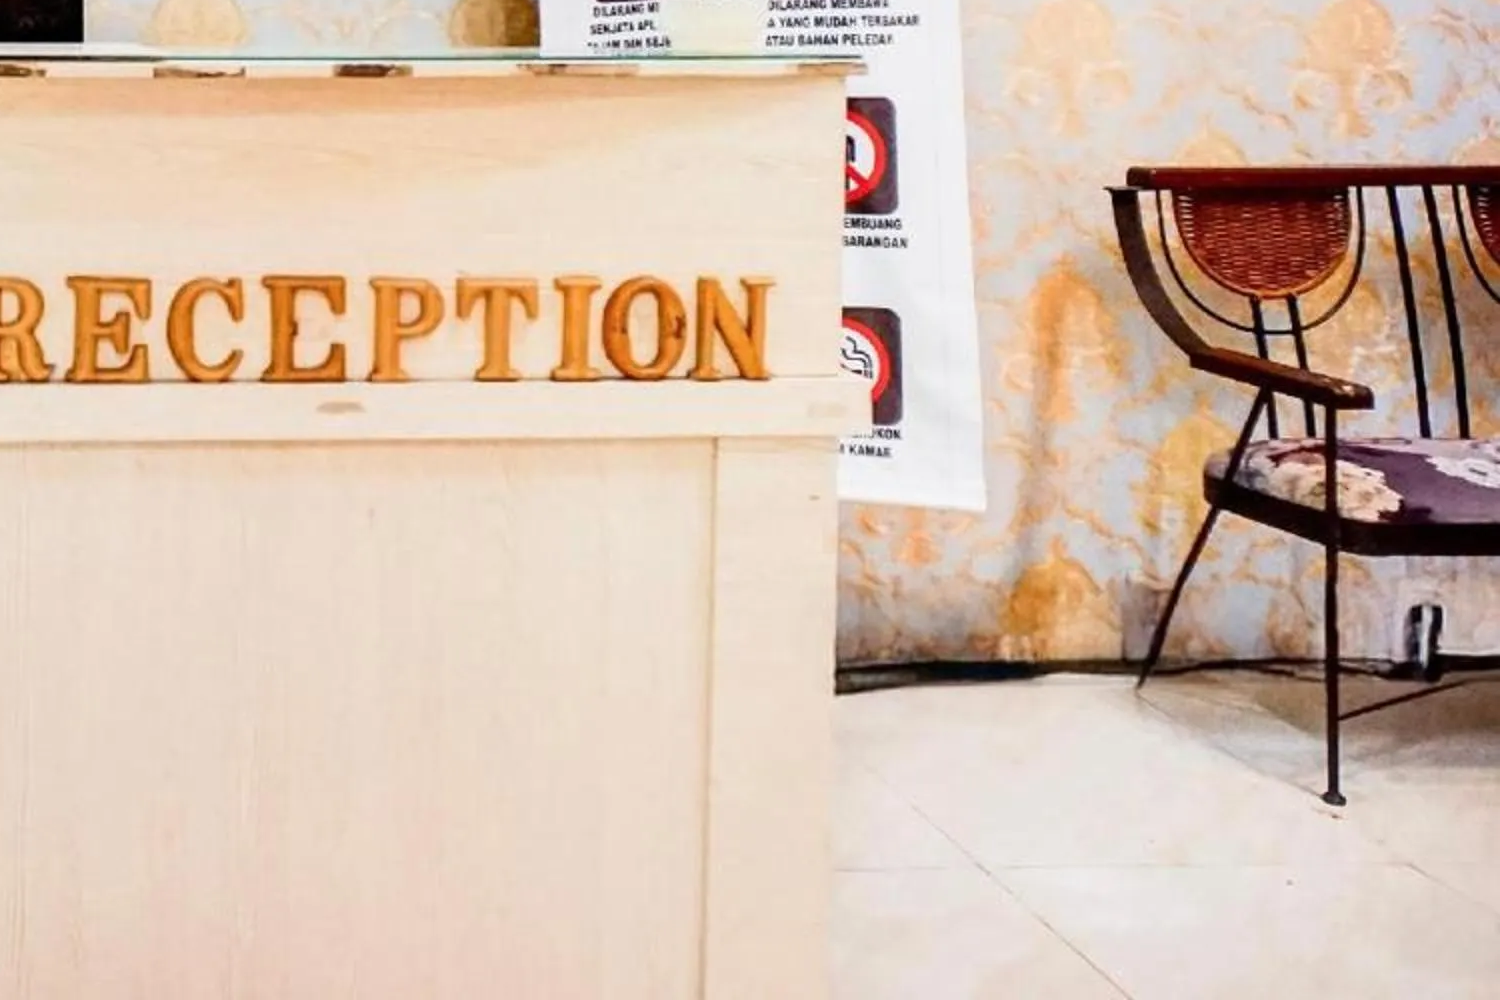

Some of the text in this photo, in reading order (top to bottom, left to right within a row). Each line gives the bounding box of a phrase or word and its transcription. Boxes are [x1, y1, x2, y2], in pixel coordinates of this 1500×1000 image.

[593, 2, 645, 18] DILARANG
[590, 21, 635, 35] SENJATA
[780, 16, 809, 28] YANG
[814, 15, 856, 28] MUDAH
[861, 14, 919, 27] TERBAKAR
[765, 34, 794, 47] ATAU
[844, 217, 902, 231] EMBUANG
